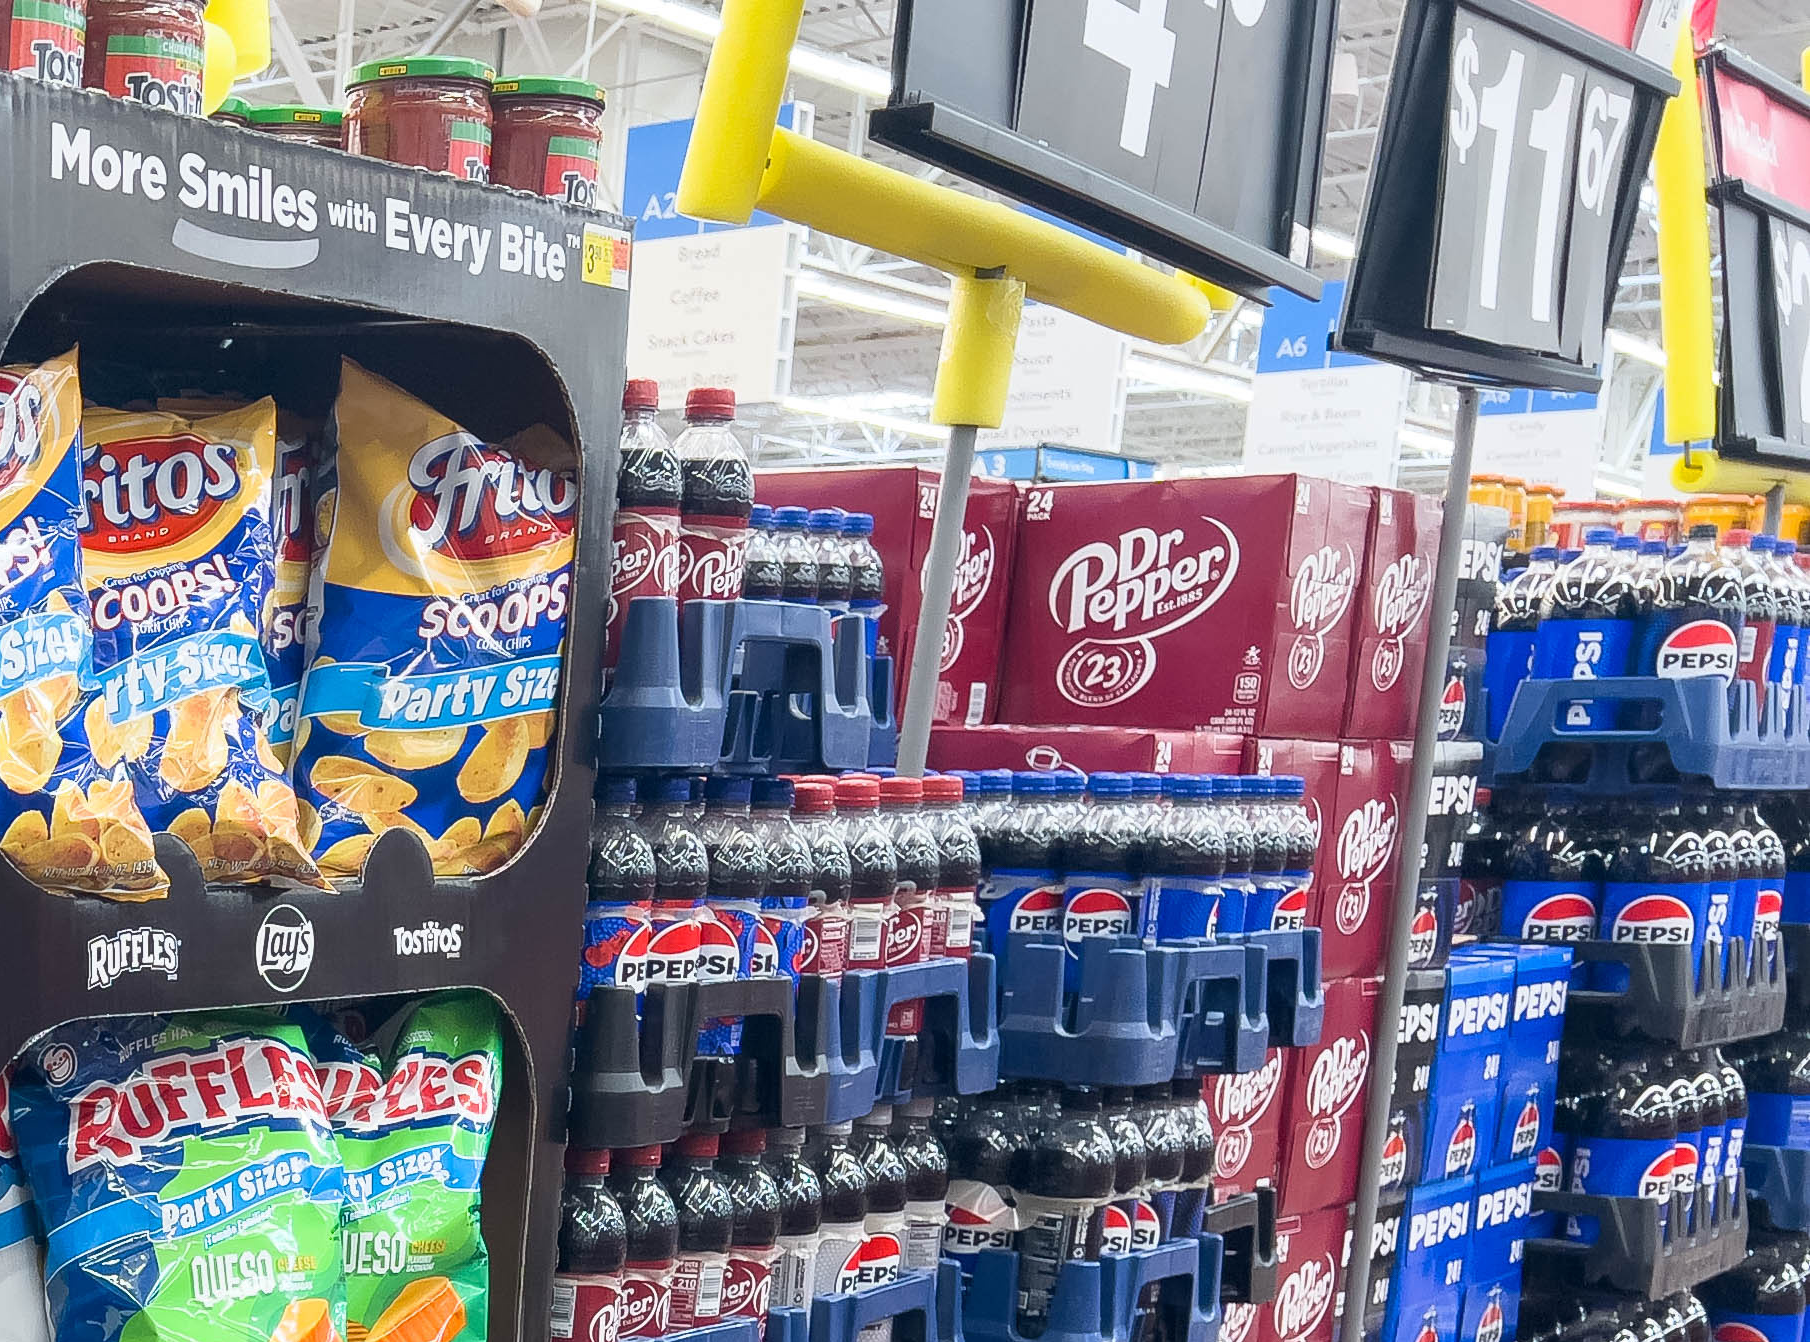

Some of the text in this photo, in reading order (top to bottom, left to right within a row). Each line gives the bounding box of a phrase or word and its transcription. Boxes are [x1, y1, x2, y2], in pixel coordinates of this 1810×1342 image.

[51, 123, 165, 200] More
[179, 153, 317, 231] Smiles
[328, 199, 376, 235] with
[385, 199, 491, 275] Every
[499, 226, 565, 281] Bite
[1276, 337, 1308, 359] A6
[1027, 510, 1051, 521] PACK
[1029, 491, 1054, 511] 24
[110, 528, 169, 543] BRAND
[486, 523, 552, 545] BRAND
[1120, 528, 1184, 582] Dr
[1318, 544, 1341, 582] Dr
[1399, 553, 1422, 588] Dr
[1051, 542, 1226, 633] Pepper
[1292, 553, 1352, 630] Pepper
[178, 640, 252, 690] Size!
[1087, 653, 1122, 688] 23
[1298, 647, 1311, 671] 23
[1663, 653, 1733, 670] PEPSI
[380, 674, 491, 724] Party
[1239, 677, 1257, 689] 150
[1362, 799, 1387, 836] Dr
[1339, 808, 1396, 878] Pepper
[1067, 917, 1130, 934] PEPSI
[1617, 926, 1689, 942] PEPSI
[89, 928, 178, 987] RUFFLES
[261, 921, 313, 975] Lay's
[1448, 993, 1509, 1037] PEPSI
[1513, 981, 1568, 1022] PEPSI
[1334, 1037, 1356, 1072] Dr
[71, 1043, 328, 1165] RUFFLES
[380, 1149, 444, 1185] Size!
[162, 1152, 302, 1233] Party Size!
[1477, 1183, 1531, 1229] PEPSI
[944, 1228, 1011, 1246] PEPSI
[1409, 1202, 1469, 1251] PEPSI
[192, 1250, 275, 1307] QUESO
